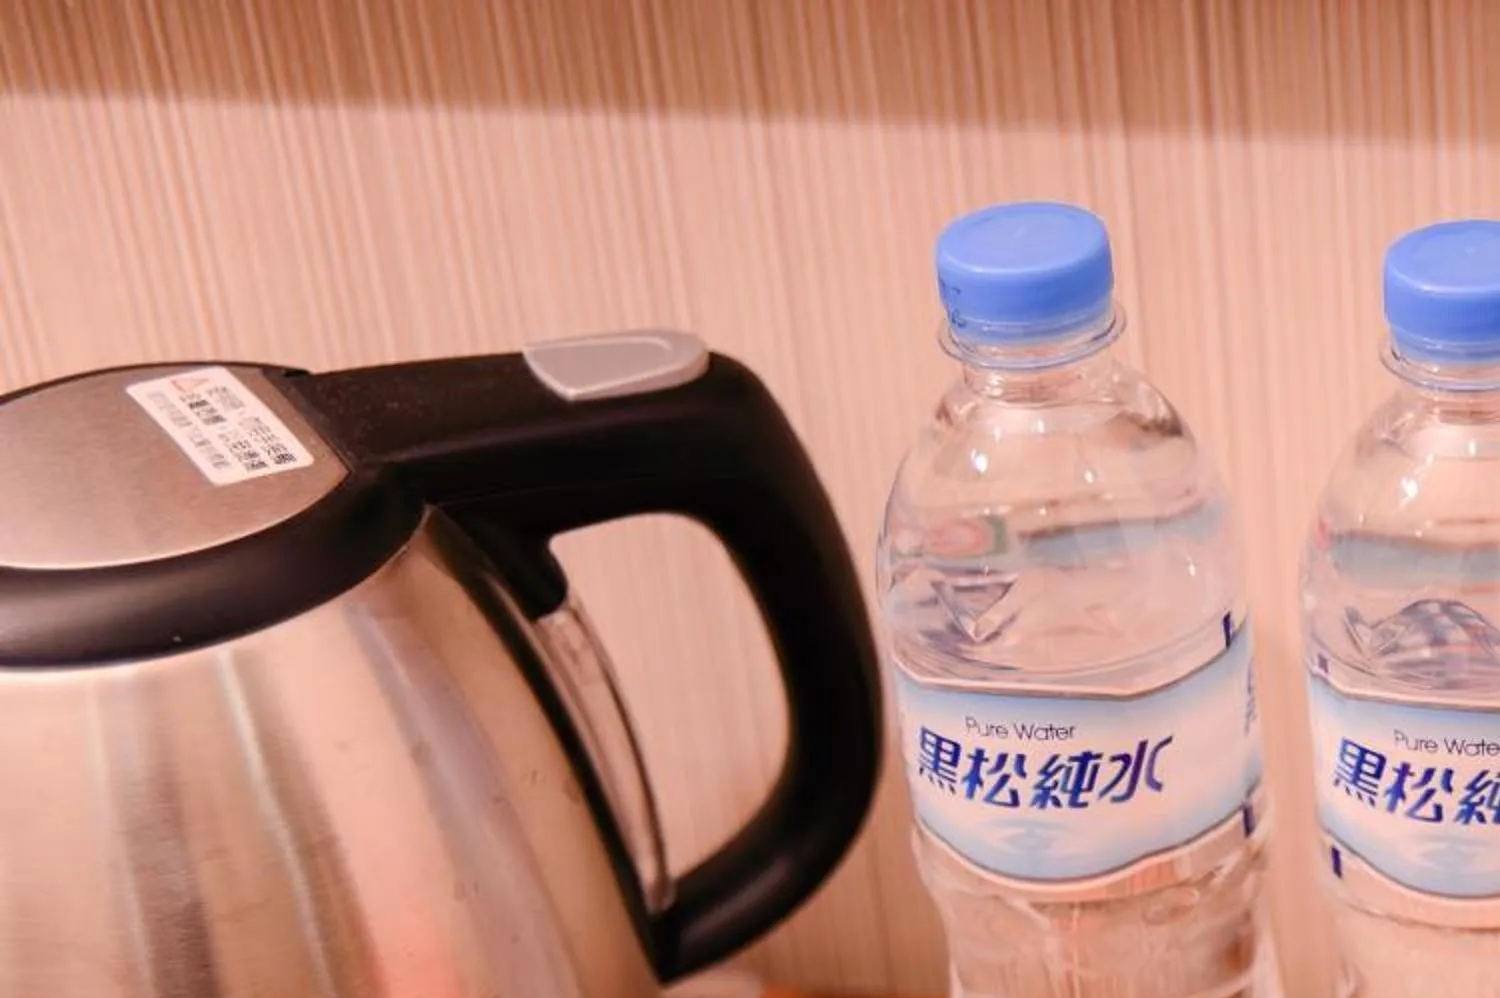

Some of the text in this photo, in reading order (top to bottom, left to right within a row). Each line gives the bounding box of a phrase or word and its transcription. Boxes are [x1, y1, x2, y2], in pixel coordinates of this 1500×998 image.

[964, 714, 1077, 741] Pure Water
[1393, 728, 1439, 754] Pure
[918, 725, 1174, 810] 黑松純水
